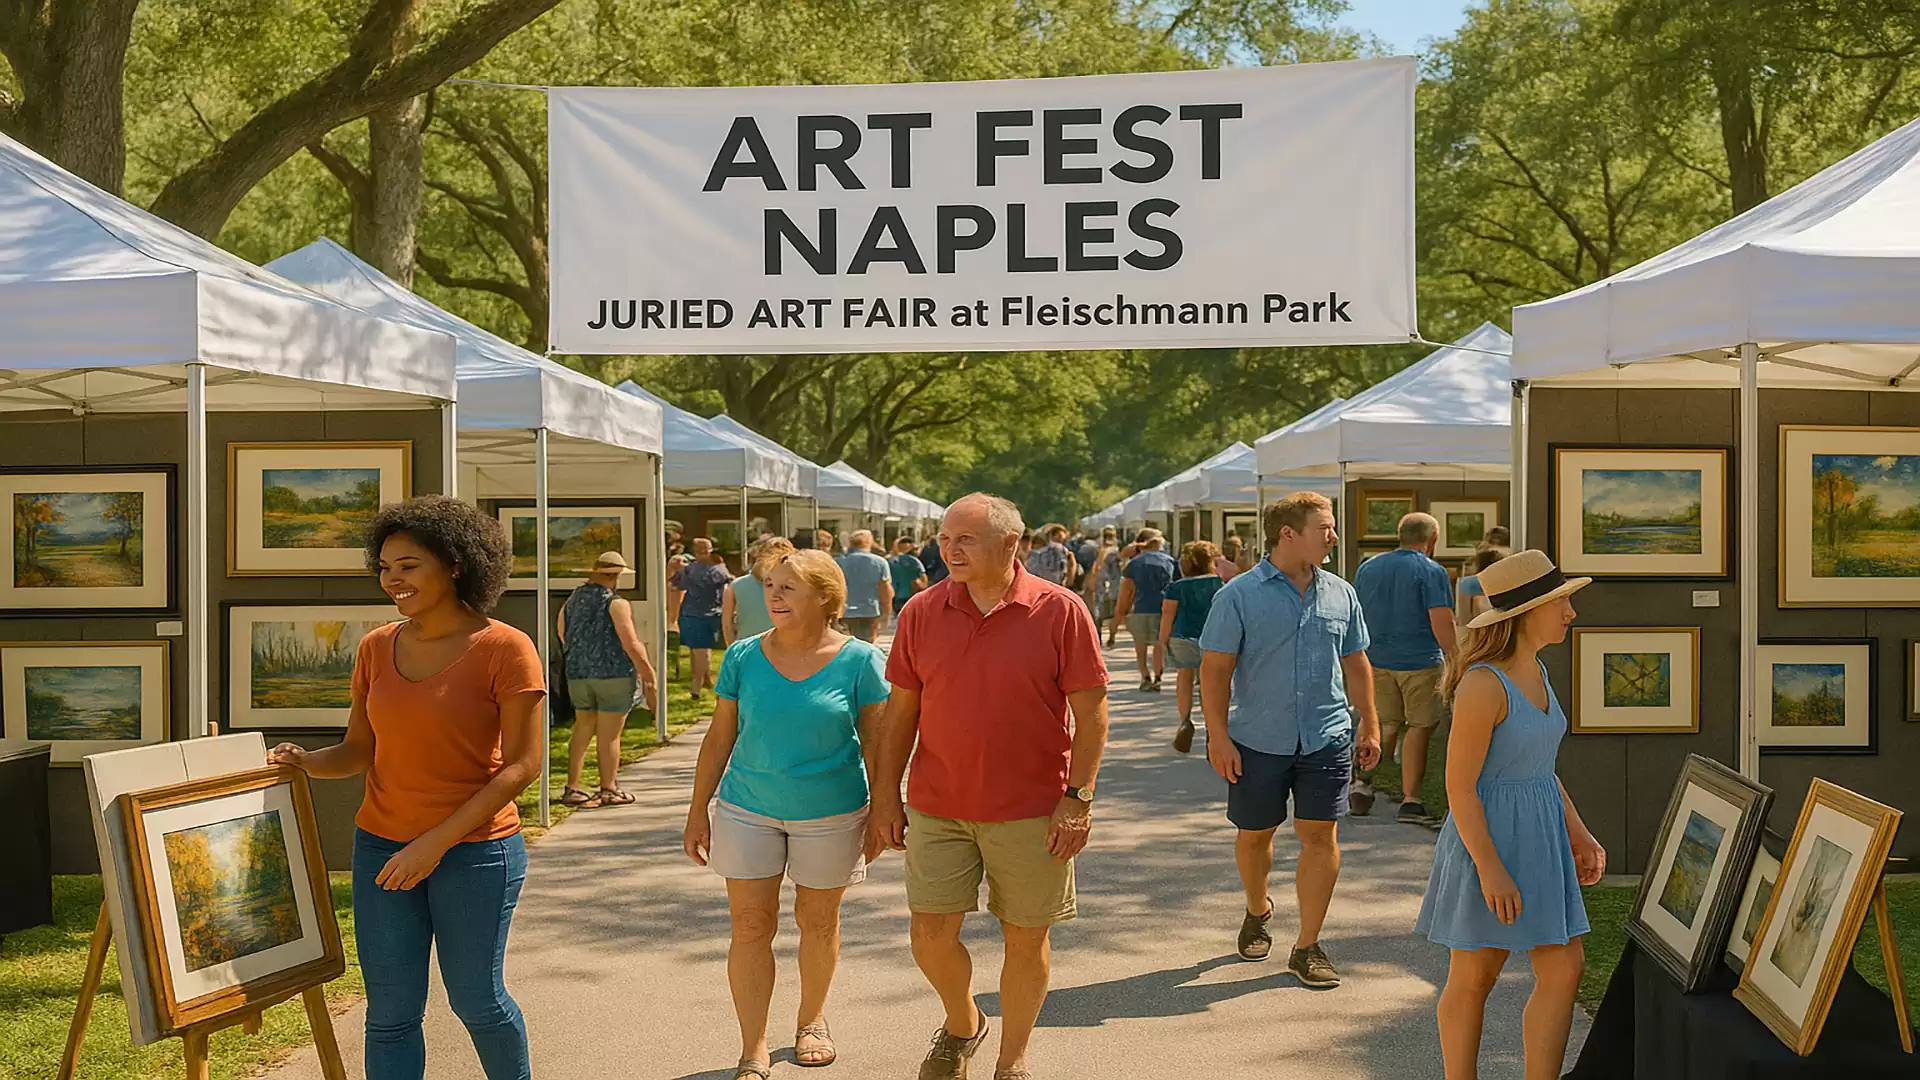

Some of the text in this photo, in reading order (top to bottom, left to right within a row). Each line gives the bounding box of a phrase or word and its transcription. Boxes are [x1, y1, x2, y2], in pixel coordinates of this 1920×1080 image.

[702, 103, 1243, 193] ART FEST
[763, 197, 1184, 276] NAPLES
[587, 291, 1353, 330] JURIED ART FAIR at Fleischmann Park
